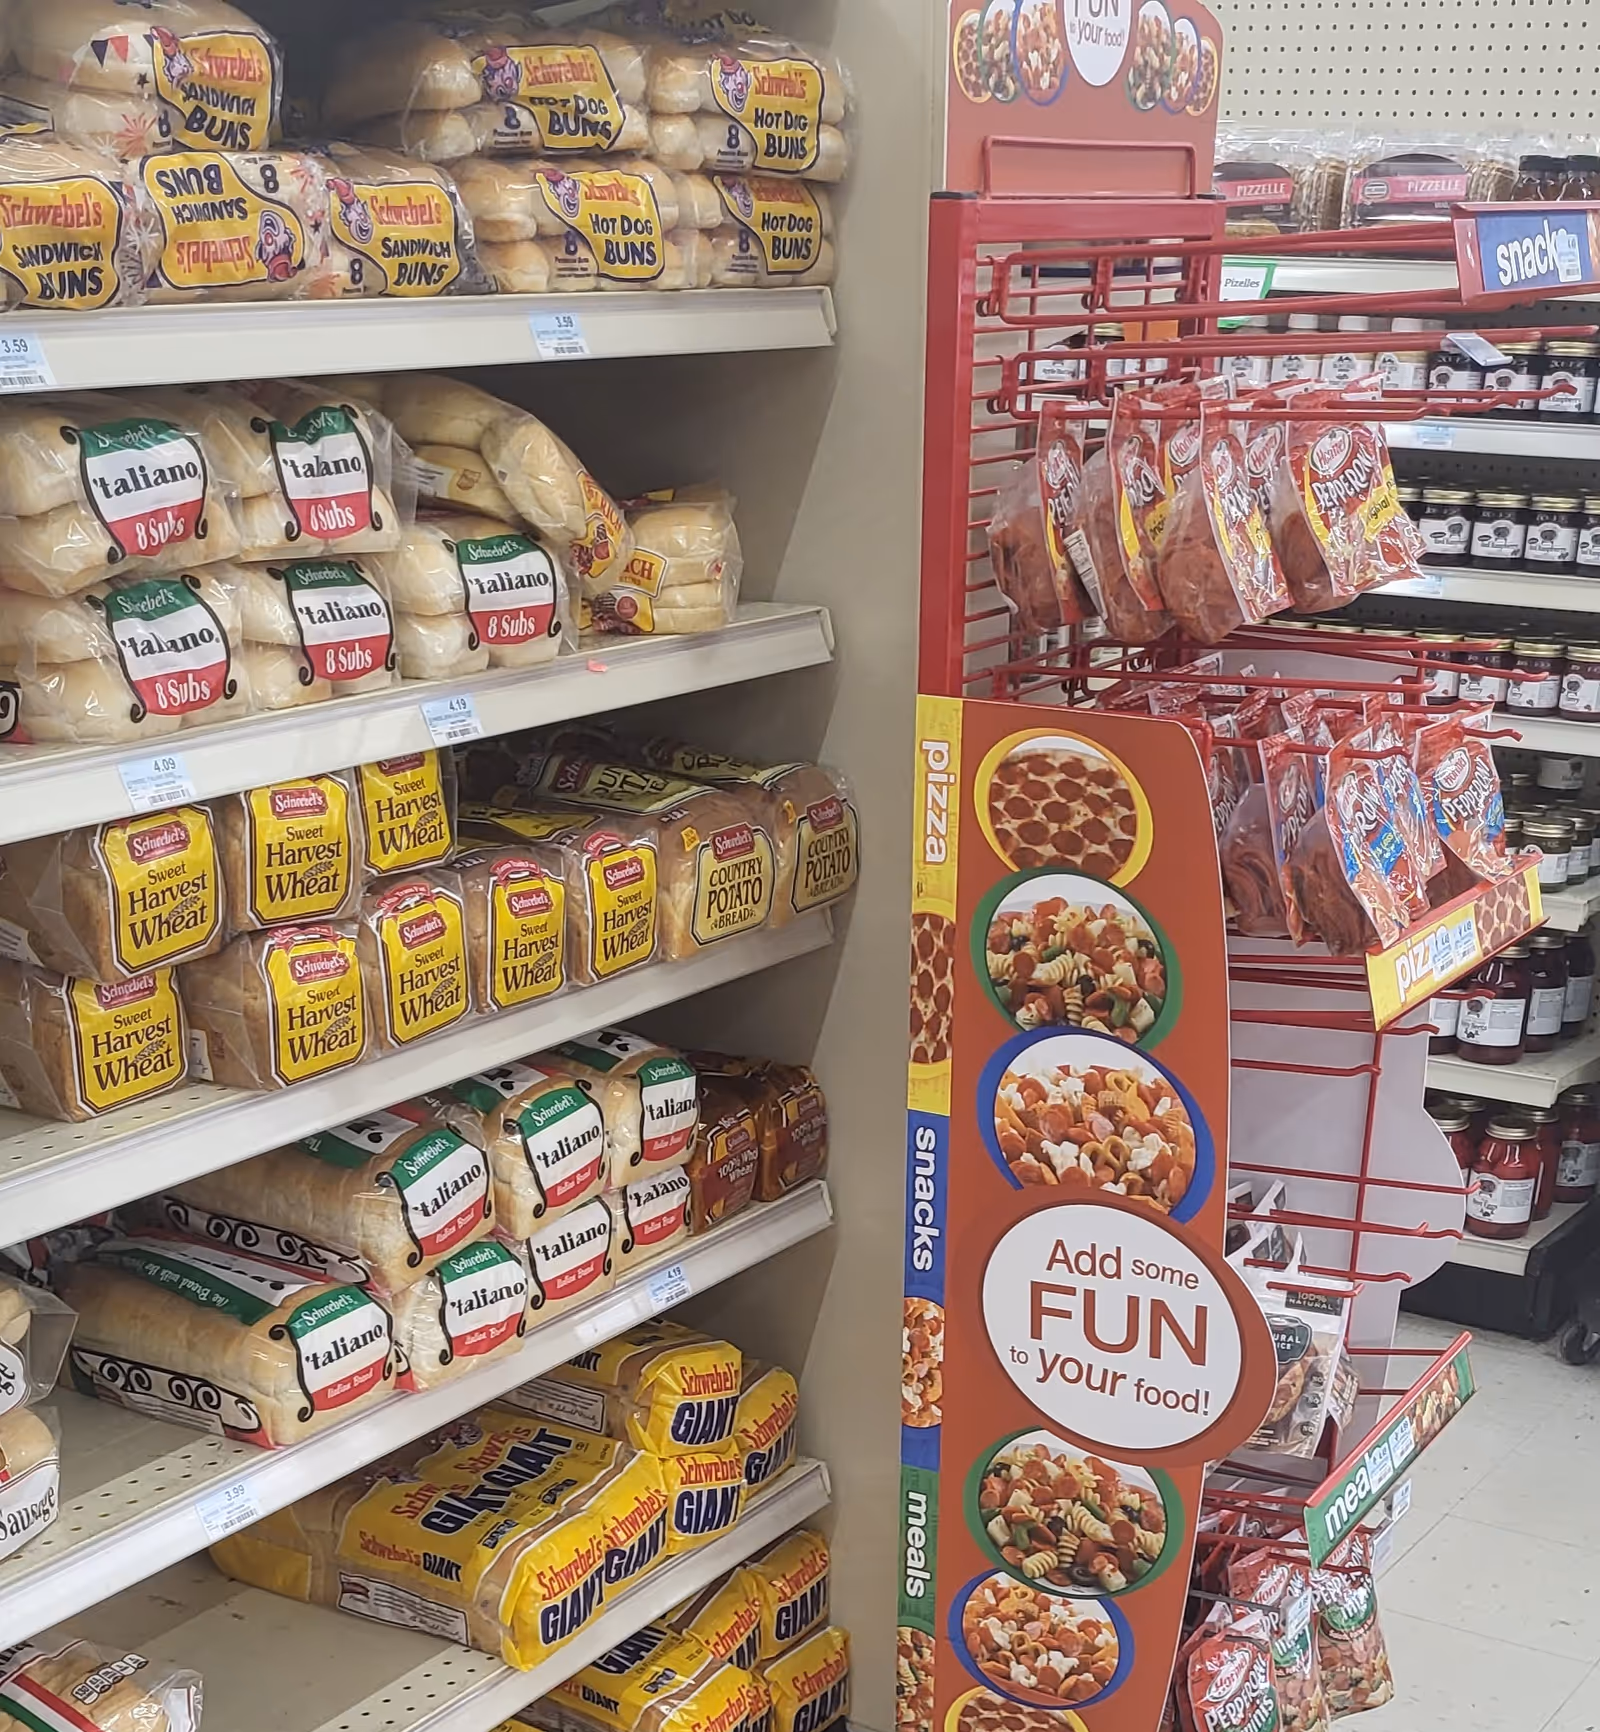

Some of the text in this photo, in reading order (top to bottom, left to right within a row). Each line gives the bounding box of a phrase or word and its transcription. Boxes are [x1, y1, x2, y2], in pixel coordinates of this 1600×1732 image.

[1076, 21, 1103, 46] your
[1104, 29, 1125, 48] food!
[180, 82, 257, 116] SANDWICH
[574, 94, 608, 116] DOG
[157, 109, 169, 138] 8
[184, 105, 252, 151] BUNS
[504, 106, 521, 130] 8
[548, 110, 612, 139] BUNS
[753, 108, 808, 132] HOT DOG
[726, 124, 740, 148] 8
[765, 134, 807, 160] BUNS
[155, 164, 223, 198] BUNS
[259, 164, 280, 193] 8
[1237, 182, 1285, 196] PIZZELLE
[1407, 178, 1462, 192] PIZZELLE
[0, 194, 105, 230] Schwebel's
[171, 198, 248, 224] SANDWICH
[761, 212, 813, 232] HOT DOG
[589, 214, 653, 237] HOT DOG
[12, 241, 103, 268] SANDWICH
[381, 237, 451, 259] SANDWICH
[564, 230, 578, 256] 8
[604, 240, 657, 266] BUNS
[771, 235, 811, 260] BUNS
[38, 267, 104, 300] BUNS
[350, 258, 363, 284] 8
[393, 262, 448, 286] BUNS
[1224, 278, 1260, 288] Pizelles
[555, 316, 573, 329] 3.59
[2, 339, 29, 354] 3.59
[310, 502, 356, 529] 8 Subs
[136, 523, 148, 551] 8
[487, 613, 535, 636] 8 Subs
[326, 646, 373, 673] 8 Subs
[156, 674, 211, 708] 8 Subs
[449, 699, 467, 712] 4.19
[154, 758, 176, 773] 4.09
[393, 778, 426, 795] Sweet
[375, 792, 441, 824] Harvest
[921, 739, 950, 863] pizza
[286, 825, 323, 842] Sweet
[378, 819, 446, 855] Wheat
[265, 839, 343, 869] Harvest
[804, 844, 851, 883] POTATO
[148, 863, 187, 886] Sweet
[265, 869, 340, 903] Wheat
[710, 859, 763, 887] COUNTRY
[128, 875, 208, 916] Harvest
[617, 890, 642, 908] Sweet
[706, 876, 763, 919] POTATO
[128, 904, 208, 950] Wheat
[520, 921, 548, 938] Sweet
[603, 900, 653, 932] Harvest
[718, 908, 750, 931] BREAD
[503, 934, 559, 961] Harvest
[603, 926, 650, 961] Wheat
[414, 949, 445, 968] Sweet
[399, 955, 460, 995] Harvest
[503, 959, 558, 992] Wheat
[113, 1007, 152, 1029] Sweet
[286, 998, 357, 1031] Harvest
[400, 984, 461, 1026] Wheat
[92, 1019, 172, 1059] Harvest
[287, 1024, 358, 1064] Wheat
[93, 1044, 174, 1091] Wheat
[913, 1126, 937, 1272] snacks
[667, 1266, 681, 1279] 4.19
[1046, 1238, 1199, 1290] Add some
[1288, 1298, 1333, 1311] NATURAL
[1297, 1291, 1328, 1302] 100%
[1028, 1279, 1209, 1368] FUN
[1009, 1342, 1211, 1417] to your food!
[225, 1485, 245, 1501] 3.99
[359, 1531, 462, 1582] Schwebel's GIANT
[906, 1490, 928, 1600] meals
[538, 1534, 603, 1601] Schwebel's
[540, 1566, 605, 1645] GIANT
